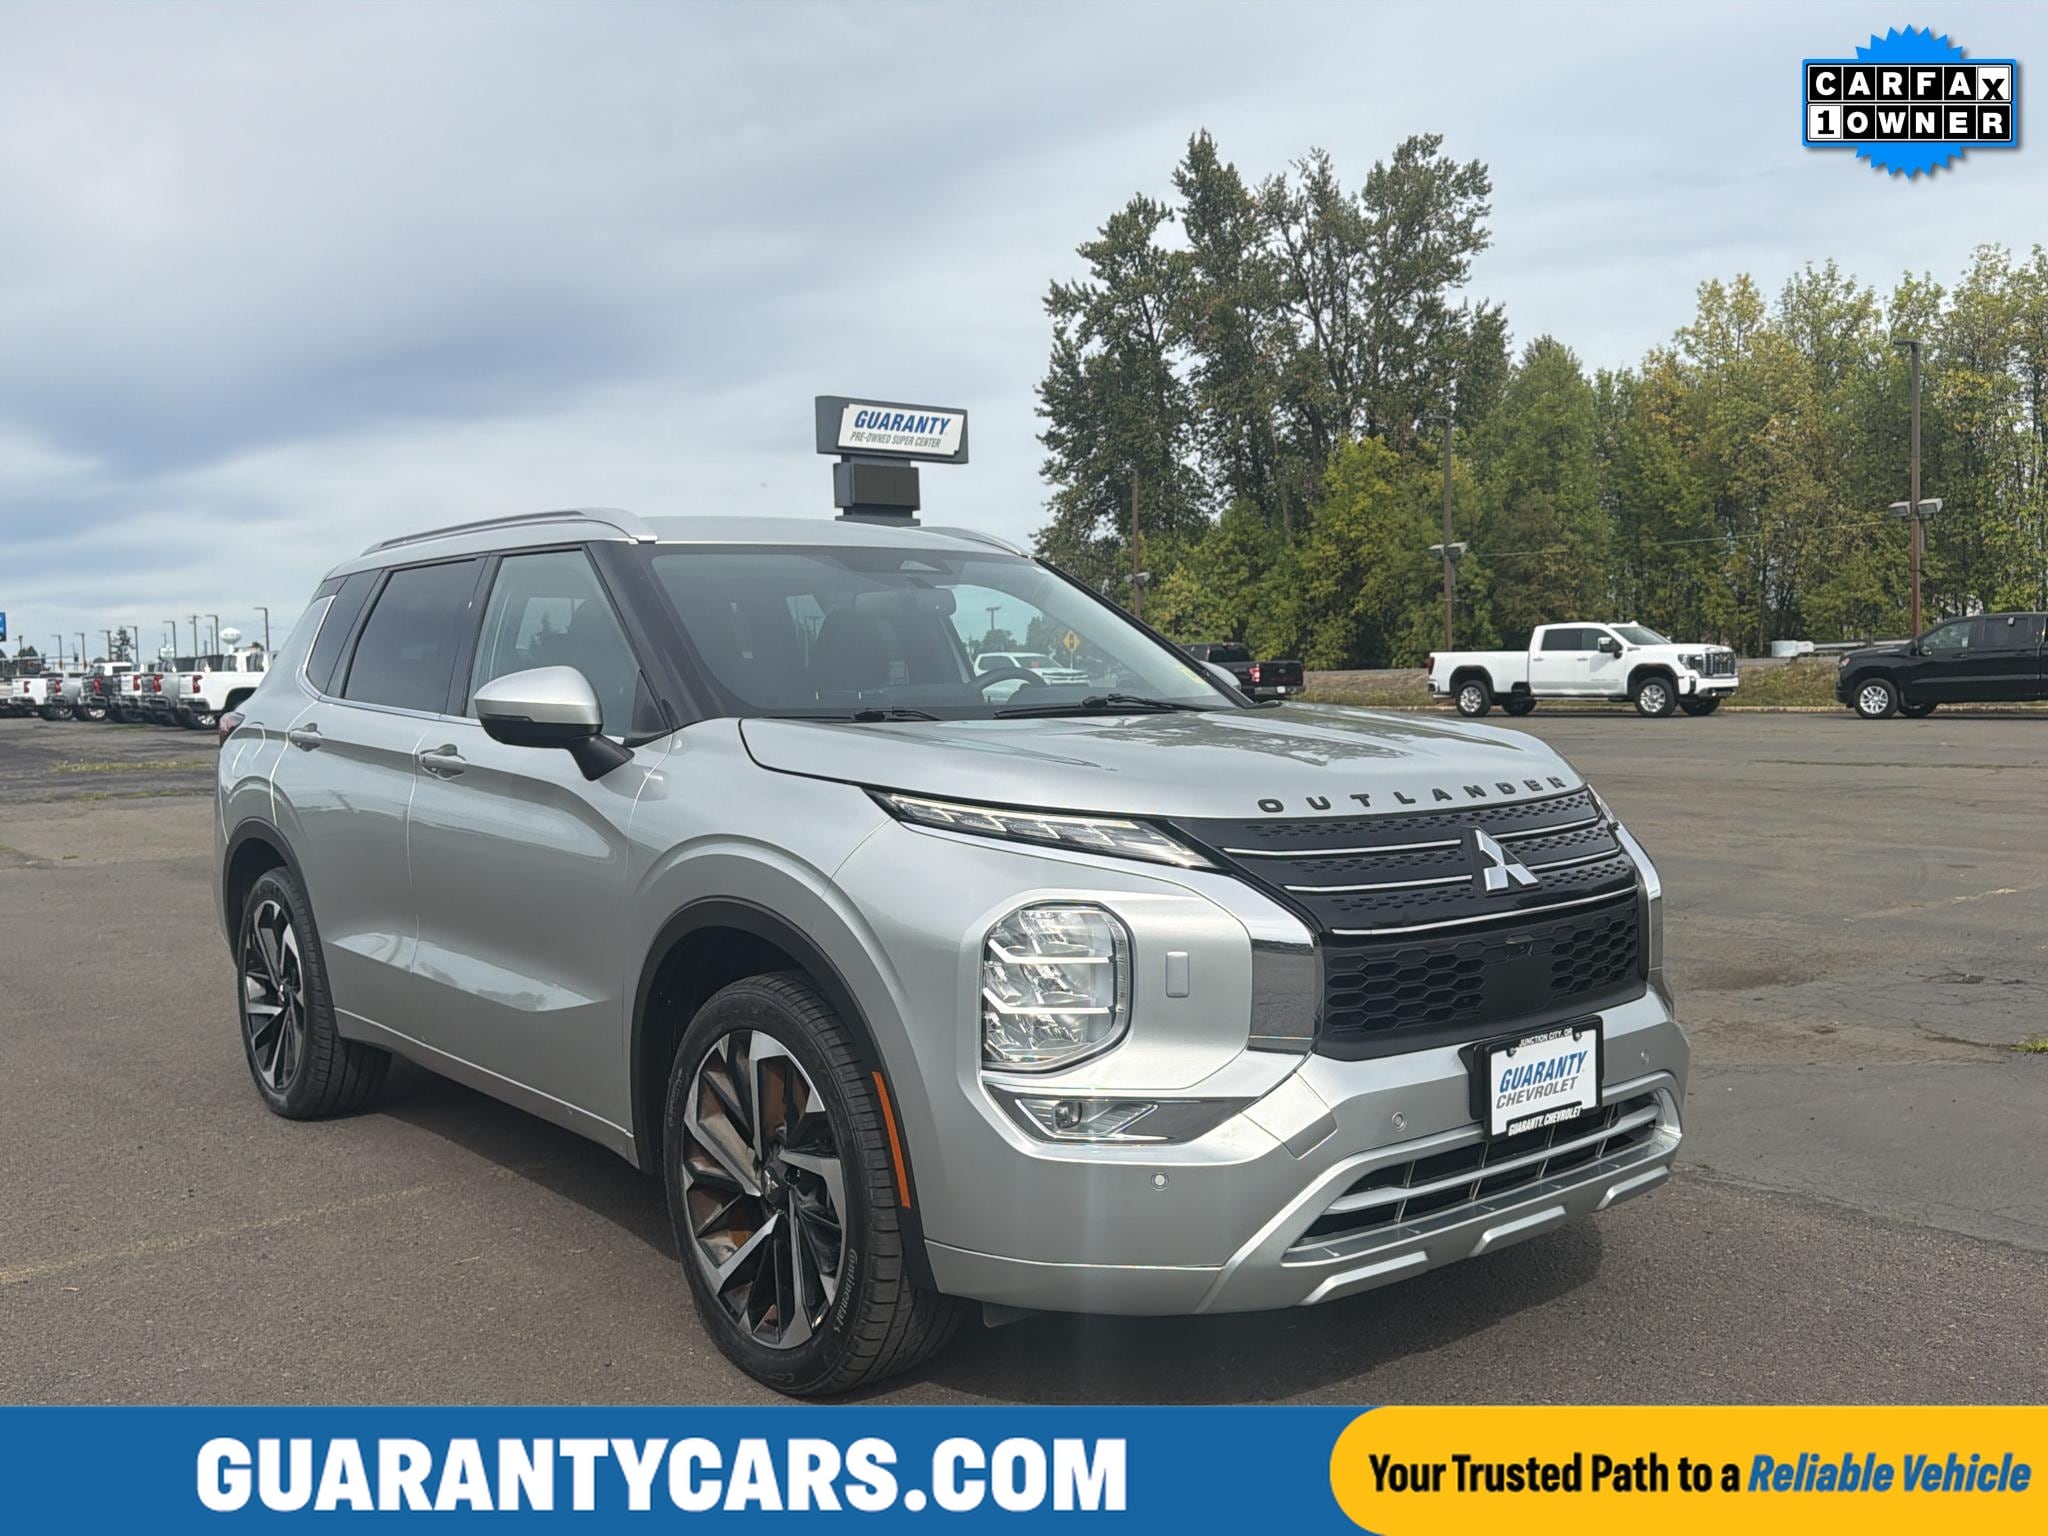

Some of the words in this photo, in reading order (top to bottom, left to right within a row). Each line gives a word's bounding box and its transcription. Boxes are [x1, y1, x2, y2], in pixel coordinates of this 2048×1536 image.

[854, 410, 952, 435] GUARANTY
[850, 431, 892, 444] PRE-OWNED
[891, 434, 915, 446] SUPER
[914, 436, 942, 448] CENTER
[1257, 775, 1568, 813] OUTLANDER
[1519, 1034, 1549, 1048] JUNCTION
[1499, 1050, 1588, 1094] GUARANTY
[1496, 1075, 1579, 1110] CHEVROLET
[1543, 1105, 1582, 1126] CHEVROLET
